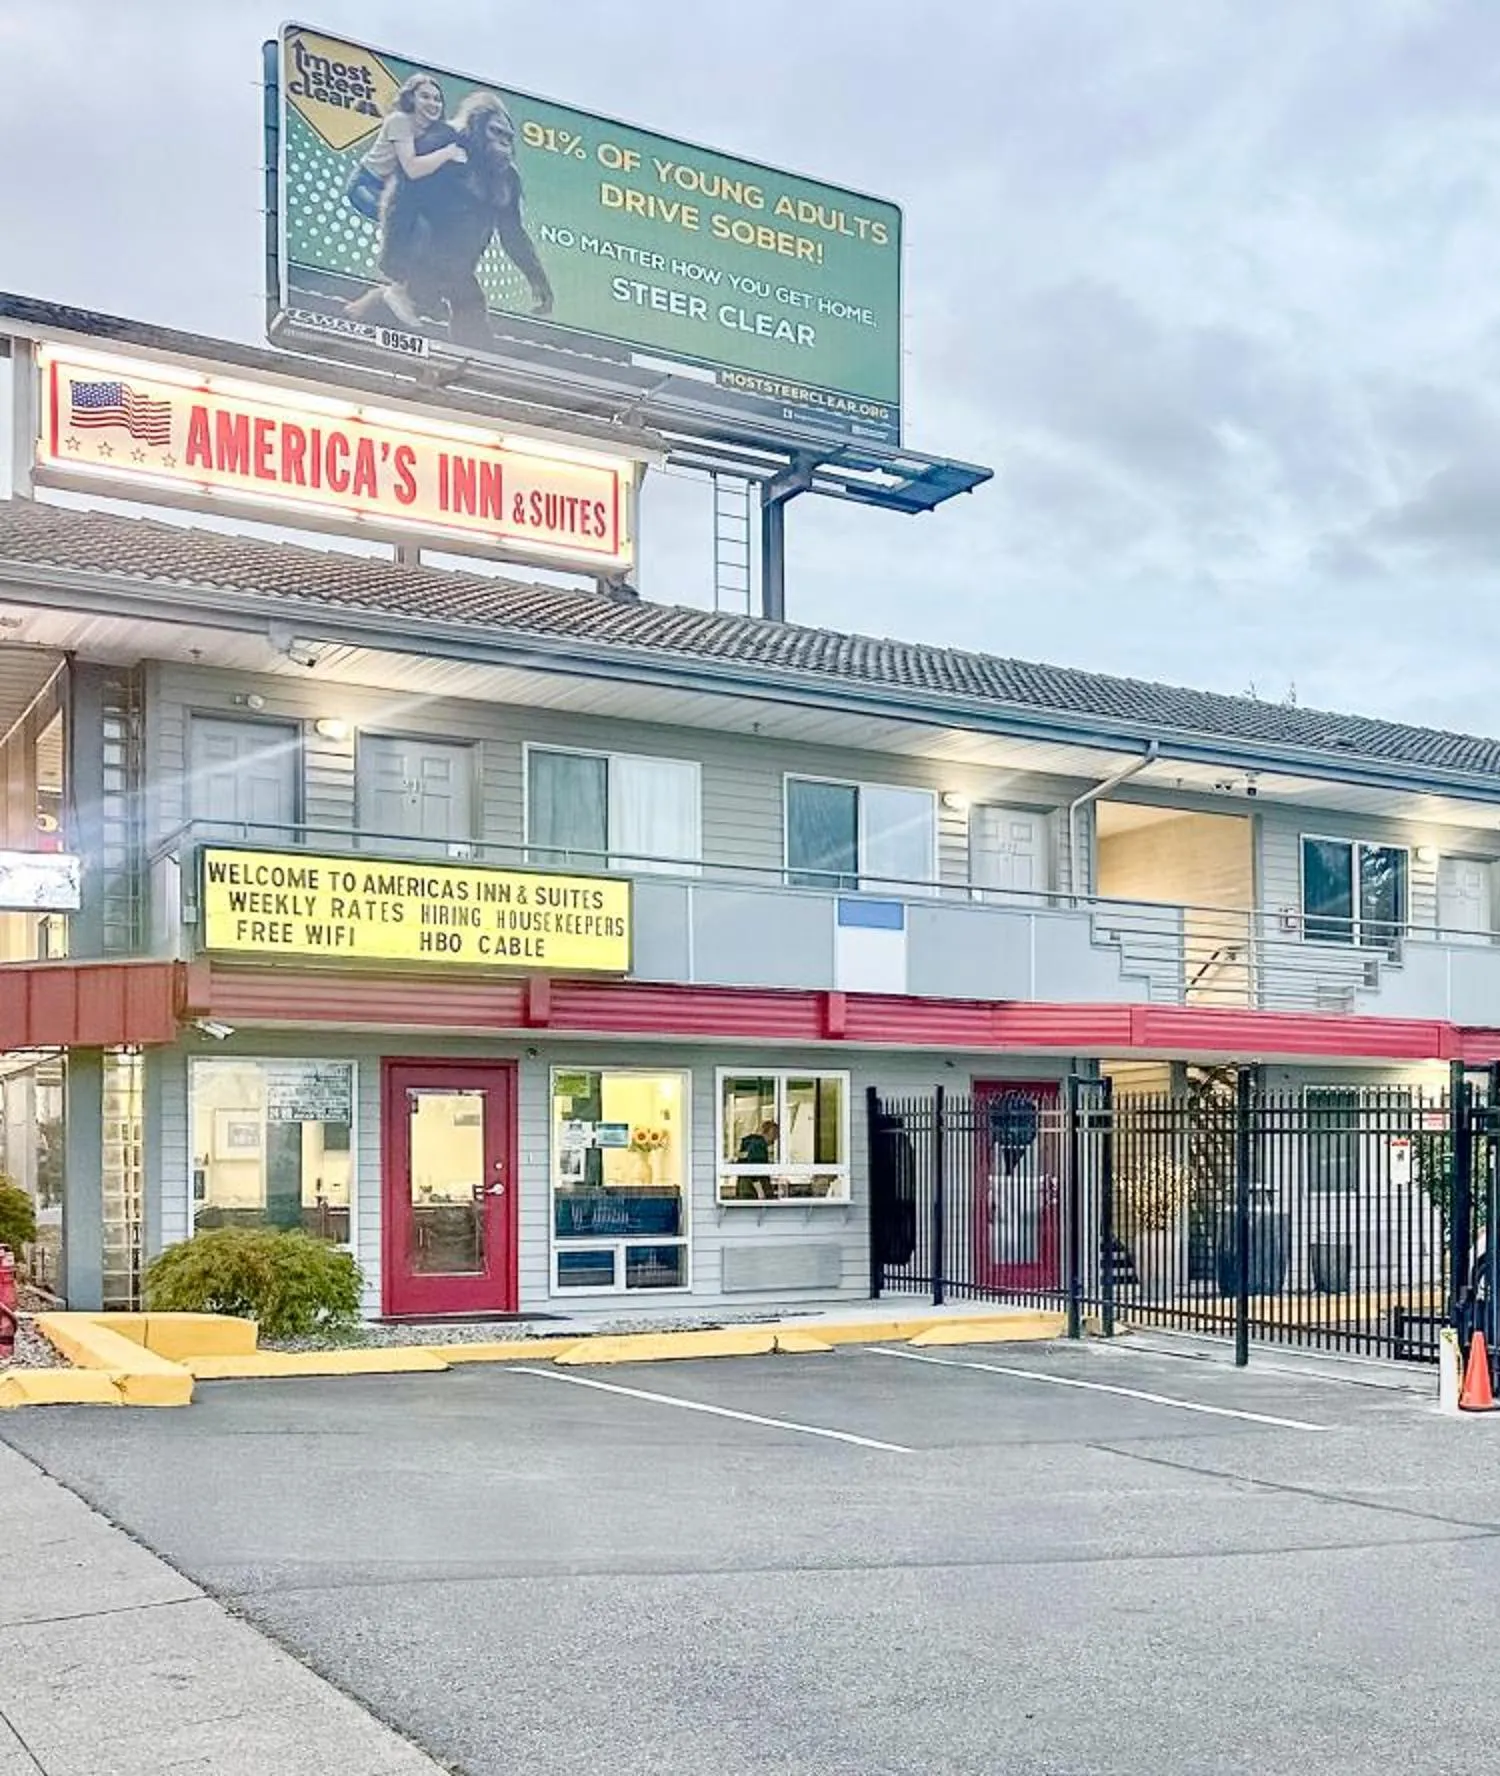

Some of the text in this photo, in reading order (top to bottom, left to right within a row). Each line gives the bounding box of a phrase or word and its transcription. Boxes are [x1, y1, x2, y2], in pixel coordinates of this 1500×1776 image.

[303, 53, 372, 85] most
[311, 70, 377, 100] steer
[288, 80, 356, 109] clear
[522, 121, 889, 246] 91% OF YOUNG ADULTS
[600, 183, 823, 264] DRIVE SOBER!
[540, 225, 575, 247] NO
[581, 236, 666, 271] MATTER
[671, 259, 722, 285] HOW
[728, 275, 770, 298] YOU
[775, 288, 813, 309] GET
[612, 277, 816, 348] STEER CLEAR
[381, 329, 424, 354] 09547
[722, 371, 889, 419] MOSTSTEERCLEAR.ORG
[186, 405, 417, 505] AMERICA'S
[438, 453, 503, 521] INN
[208, 861, 604, 910] WELCOME TO AMERICAS INN & SUITES
[229, 891, 625, 937] WEEKLY RATES HIRING HOUSEKEEPERS
[236, 920, 545, 958] FREE WIFI HBO CABLE
